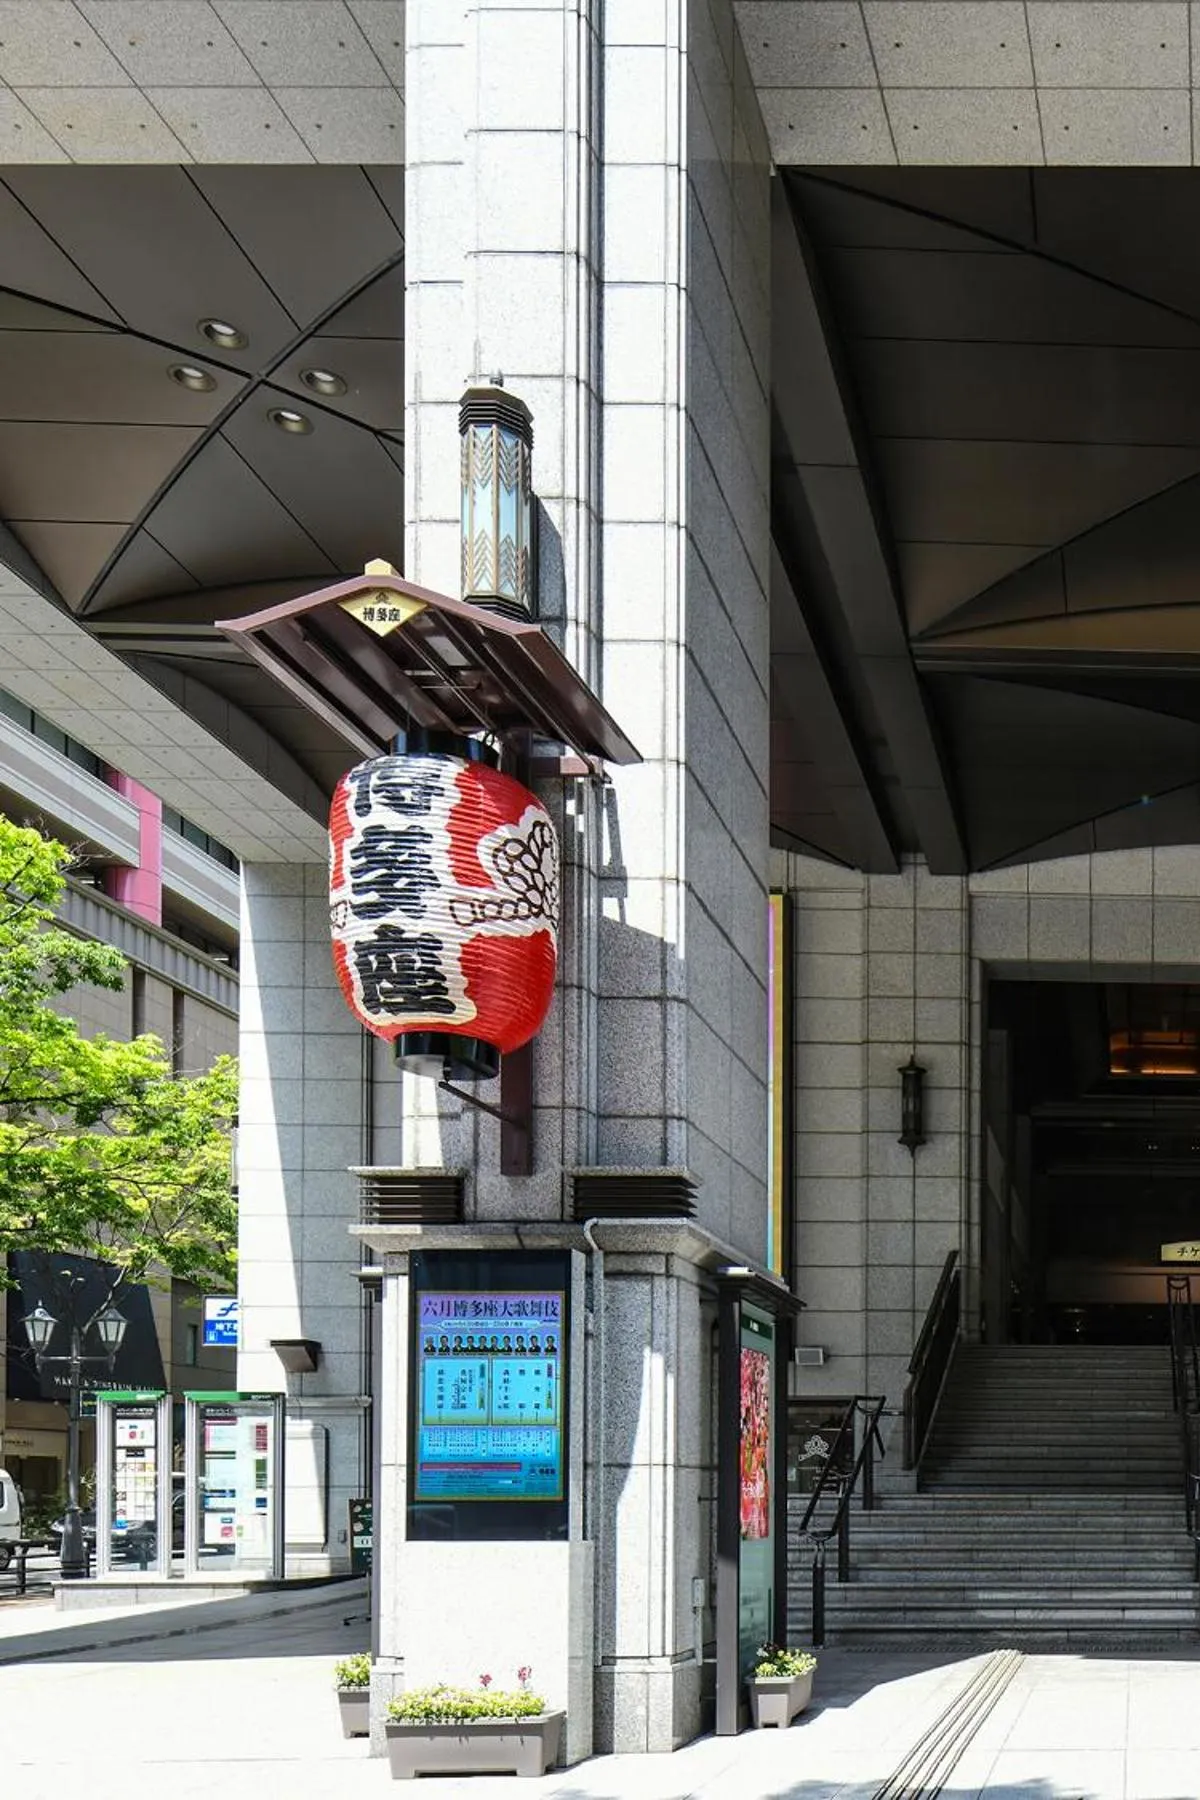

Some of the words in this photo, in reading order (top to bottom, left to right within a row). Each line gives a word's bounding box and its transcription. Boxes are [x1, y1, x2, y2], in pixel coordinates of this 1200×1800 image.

[363, 606, 401, 624] 博多座
[348, 754, 457, 1016] 博多座
[423, 1299, 559, 1318] 六月博多座大歌舞伎
